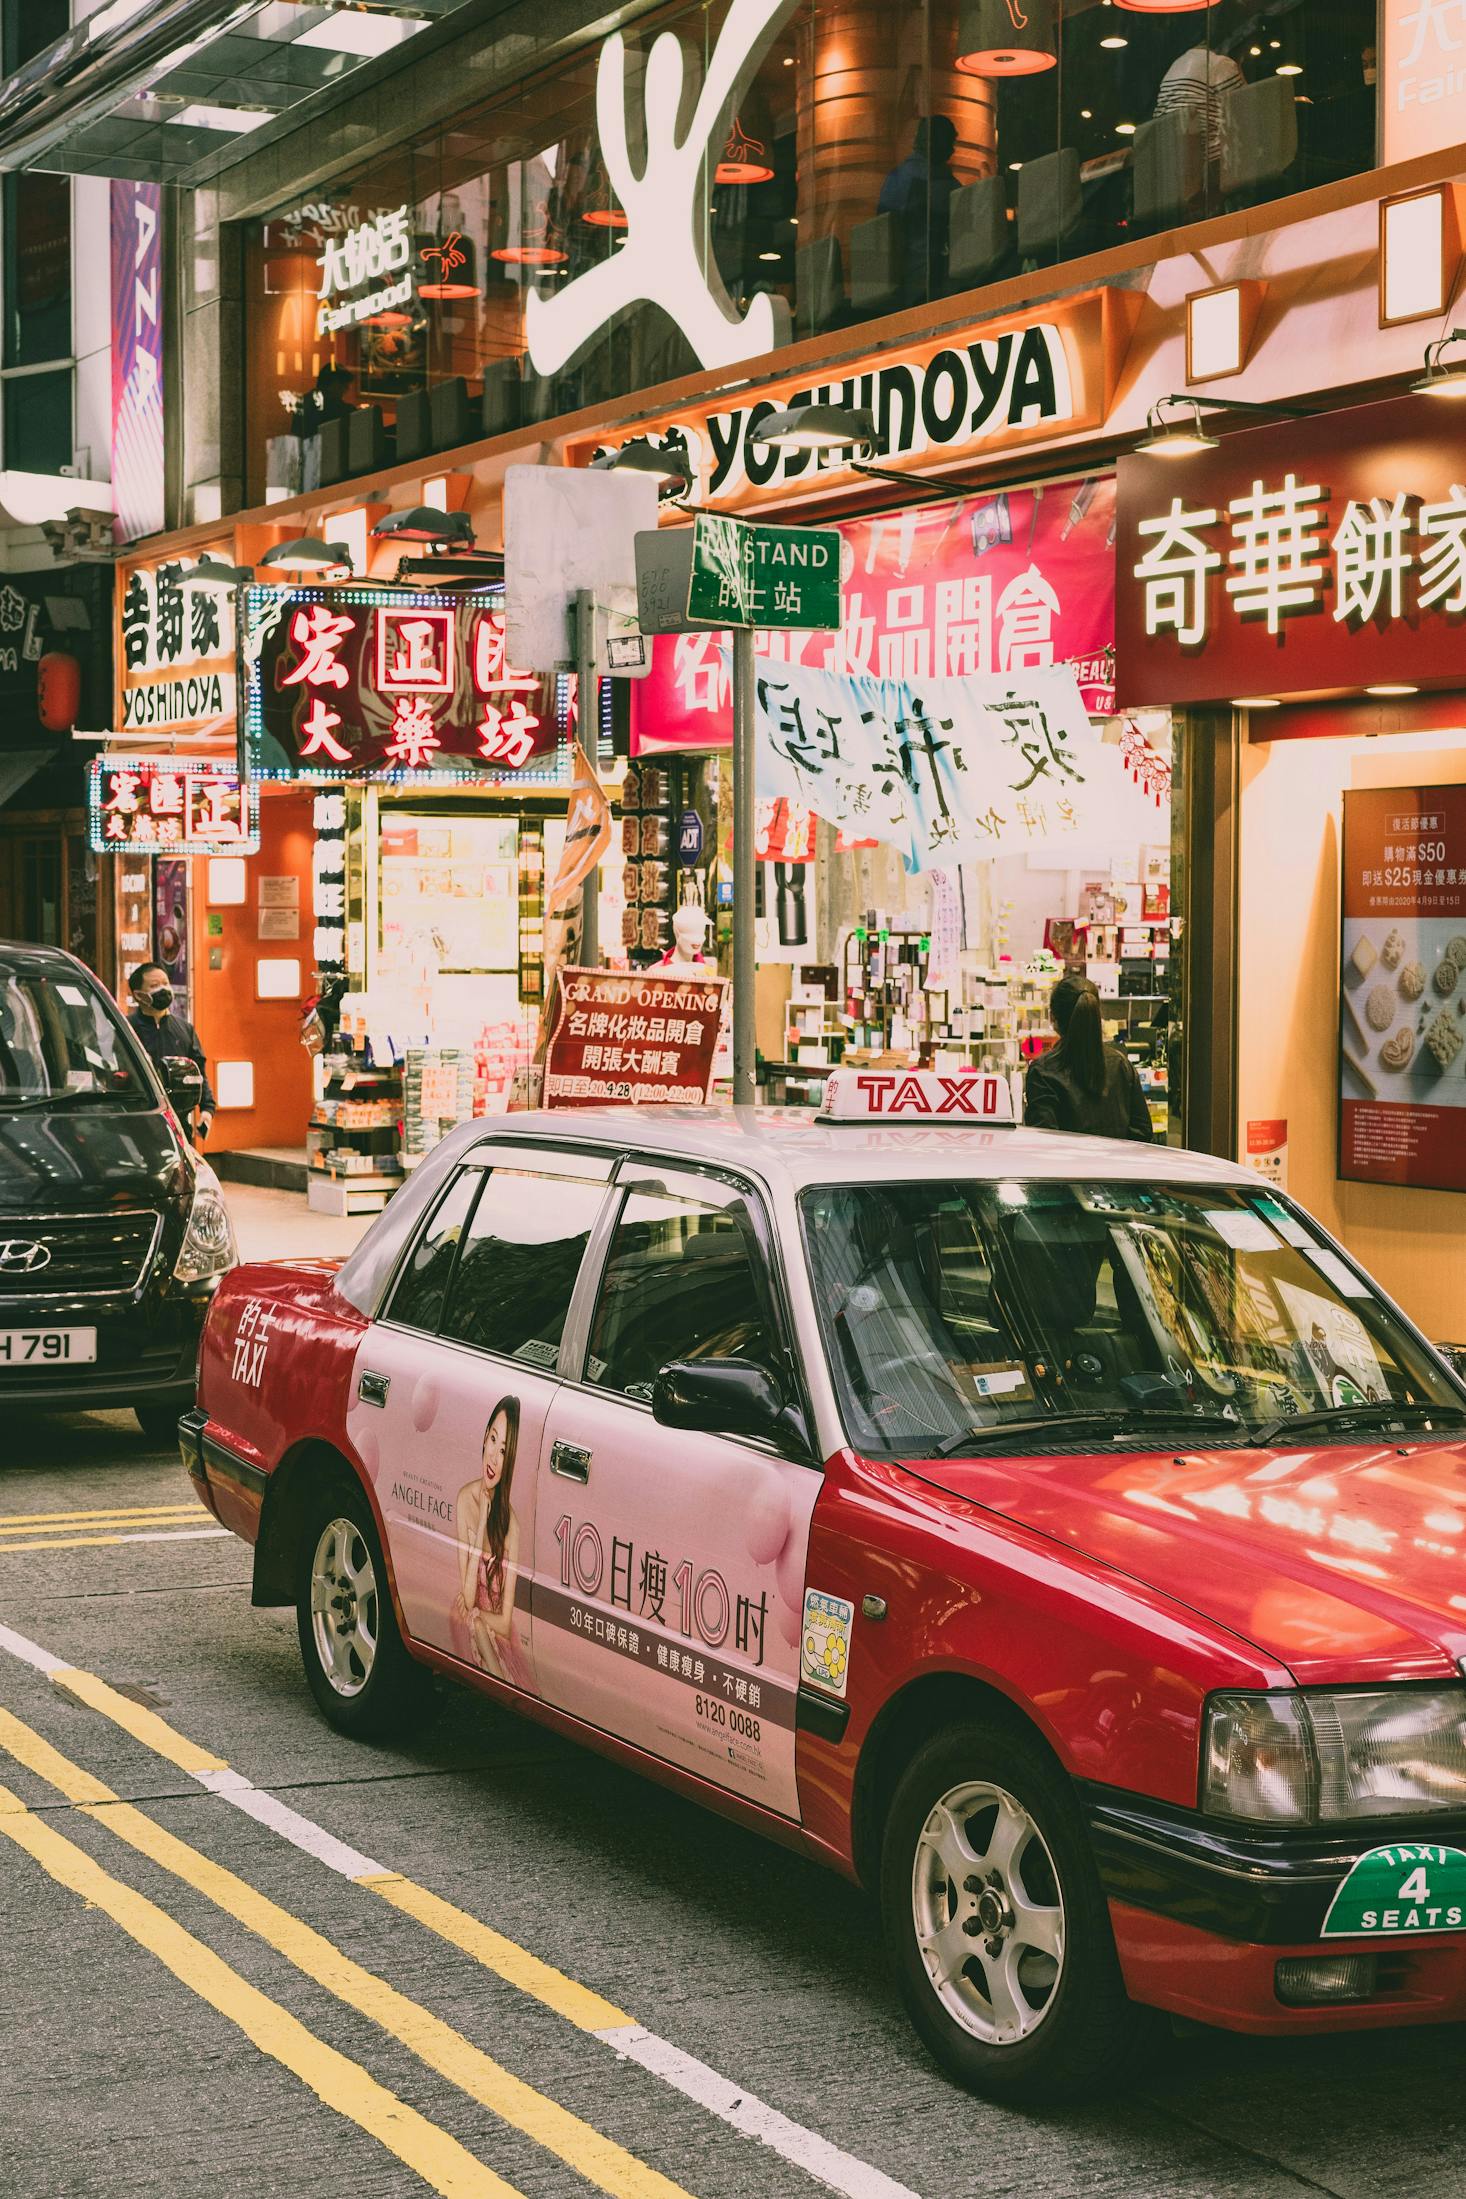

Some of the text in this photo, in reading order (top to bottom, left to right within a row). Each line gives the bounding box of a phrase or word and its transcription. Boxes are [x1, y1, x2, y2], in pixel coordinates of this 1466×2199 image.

[135, 182, 157, 416] AZA
[706, 324, 1060, 496] YOSHINOYA
[743, 540, 829, 568] STAND
[717, 576, 802, 614] 的士站
[123, 673, 223, 728] YOSHINOYA
[299, 697, 541, 768] 大藥坊
[680, 828, 699, 849] ADT
[565, 983, 719, 1013] GRAND OPENING
[568, 1010, 705, 1046] 名牌化妝品開倉
[581, 1044, 681, 1077] 開張大酬賓
[857, 1076, 998, 1114] TAXI
[237, 1298, 278, 1343] 的士
[22, 1333, 70, 1361] 791
[231, 1337, 268, 1388] TAXI
[391, 1481, 426, 1511] ANGEL
[428, 1495, 454, 1522] FACE
[695, 1694, 762, 1743] 8120 0088
[1376, 1845, 1447, 1867] TAXI
[1397, 1866, 1431, 1905] 4
[1360, 1906, 1462, 1929] SEATS
